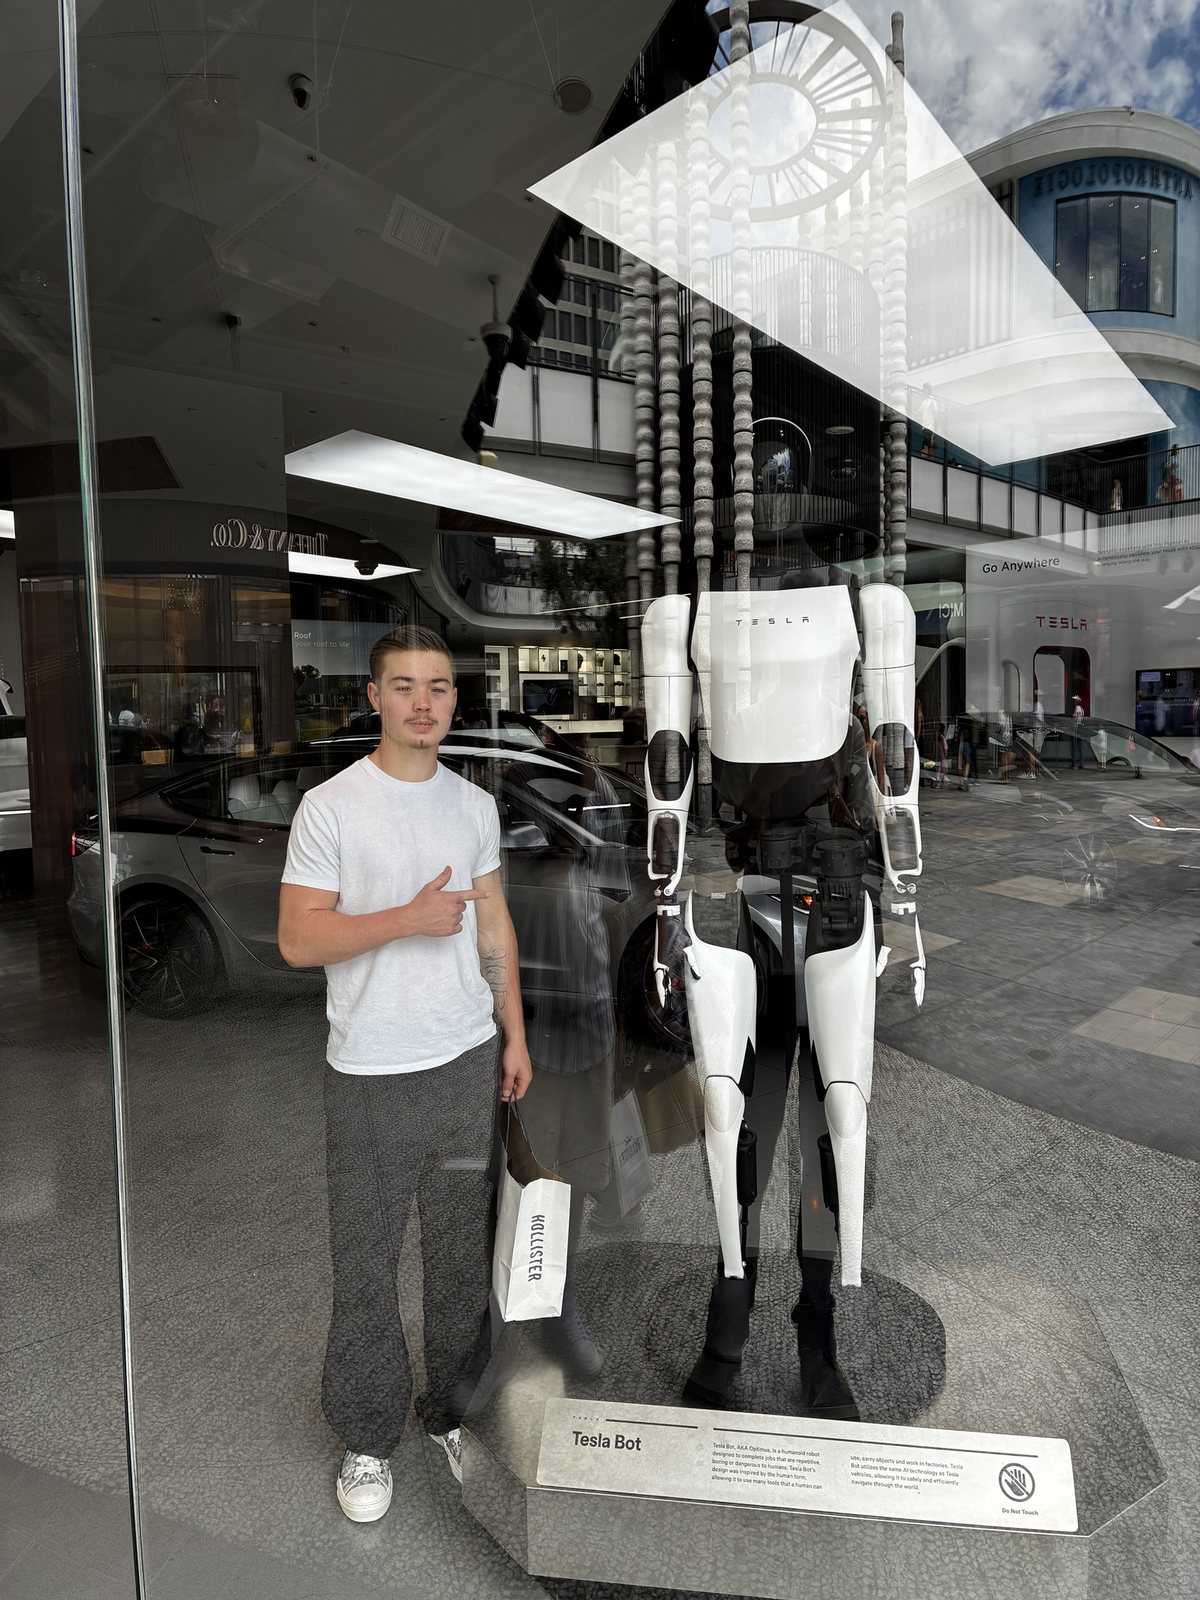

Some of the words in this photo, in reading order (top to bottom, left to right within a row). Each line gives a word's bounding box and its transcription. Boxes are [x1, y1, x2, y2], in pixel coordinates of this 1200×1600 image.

[982, 563, 998, 573] Go
[1001, 557, 1060, 572] Anywhere
[736, 616, 809, 626] TESLA
[1035, 616, 1088, 630] TESLA
[528, 1214, 545, 1282] HOLLISTER
[572, 1431, 611, 1448] Tesla
[614, 1434, 641, 1451] Bot
[749, 1446, 771, 1454] Optimus,
[910, 1468, 937, 1476] technology
[874, 1473, 895, 1481] allowing
[933, 1478, 959, 1486] efficiently
